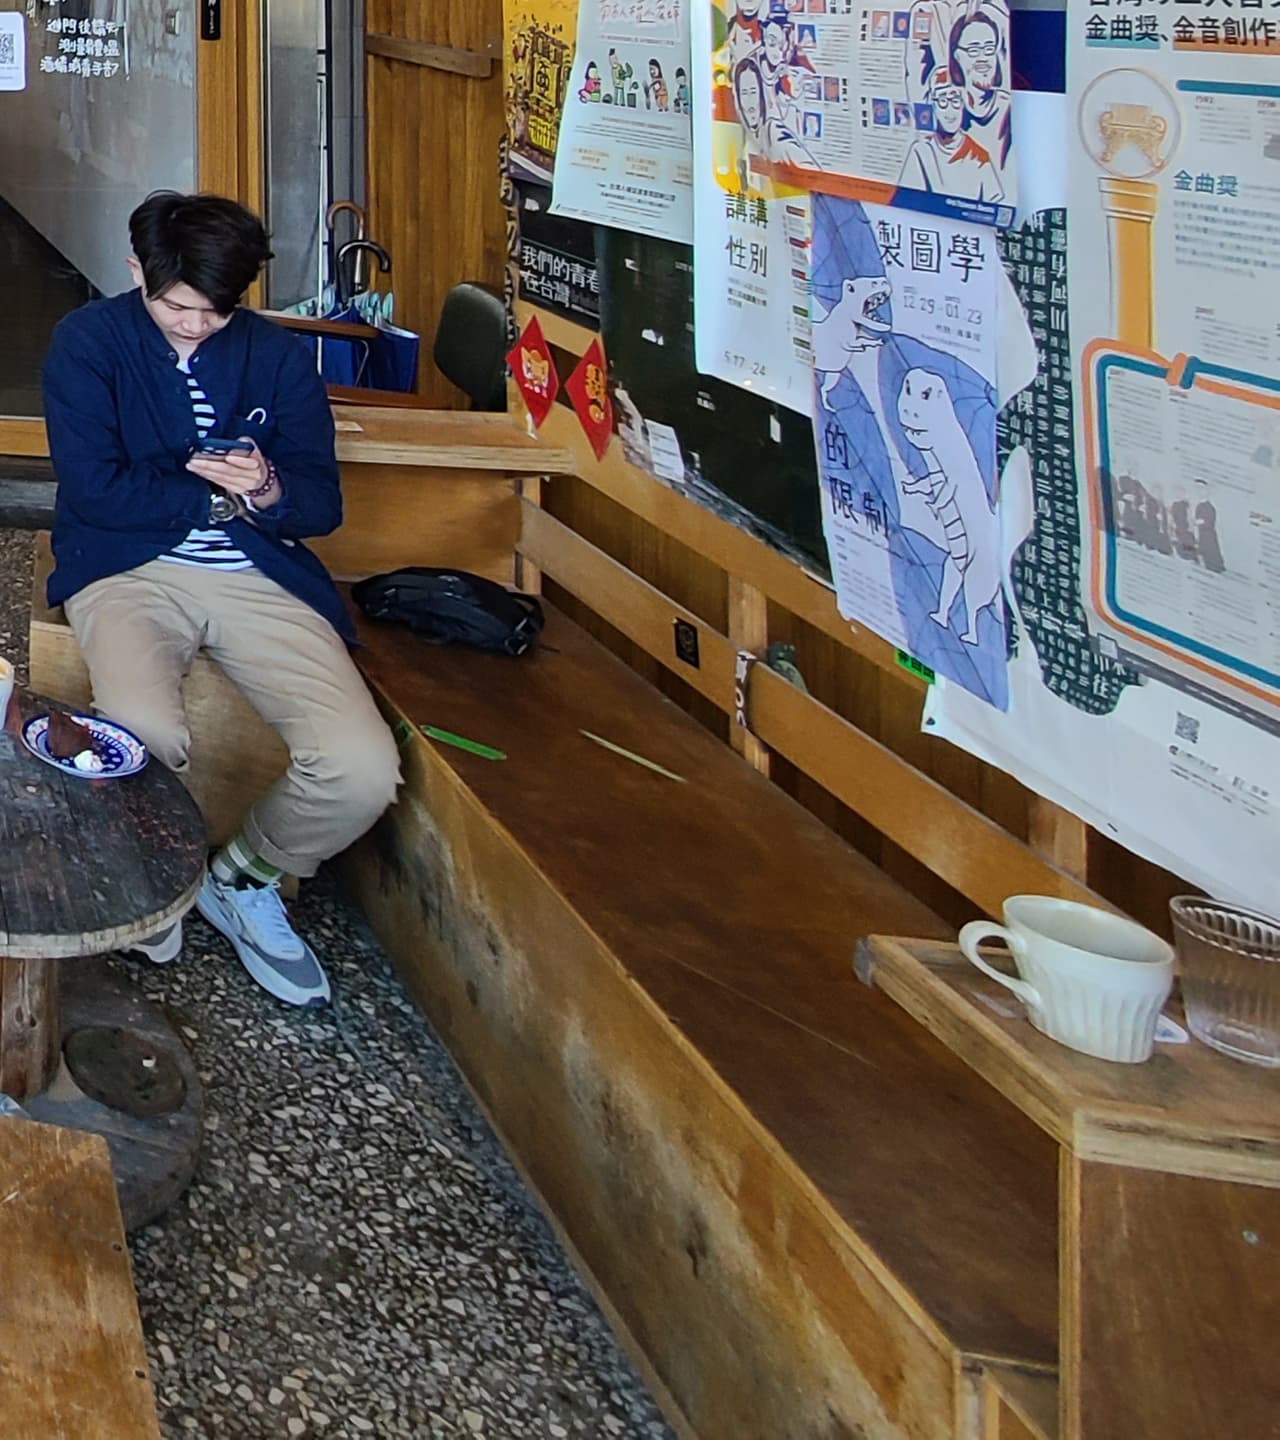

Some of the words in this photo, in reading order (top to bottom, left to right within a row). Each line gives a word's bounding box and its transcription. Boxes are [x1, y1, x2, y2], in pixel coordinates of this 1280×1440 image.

[724, 234, 769, 278] 性別
[876, 219, 986, 284] 製圖學
